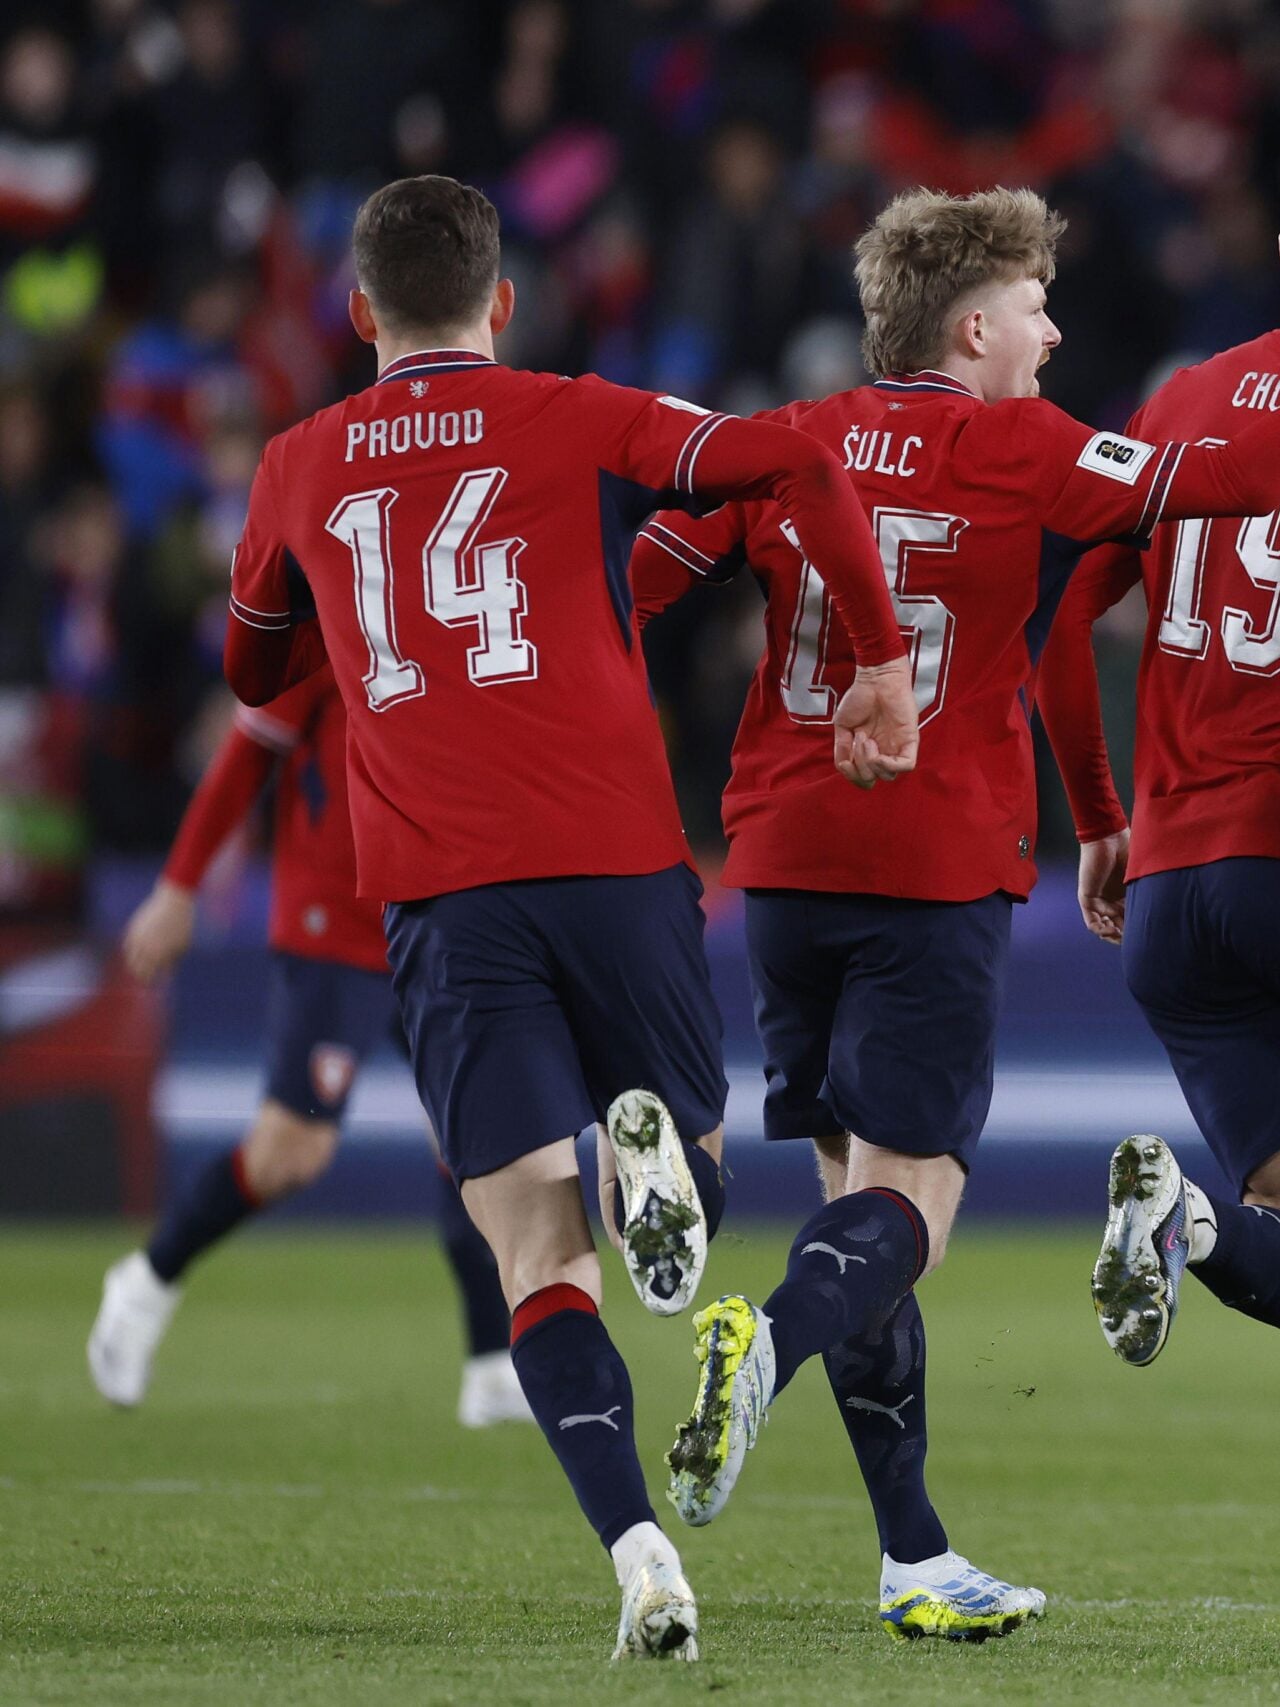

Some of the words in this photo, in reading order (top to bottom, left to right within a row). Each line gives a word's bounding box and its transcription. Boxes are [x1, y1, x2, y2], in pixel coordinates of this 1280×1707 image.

[345, 408, 484, 462] PROVOD
[842, 425, 923, 477] ŠULC
[324, 466, 538, 713] 14
[779, 505, 970, 730] 15
